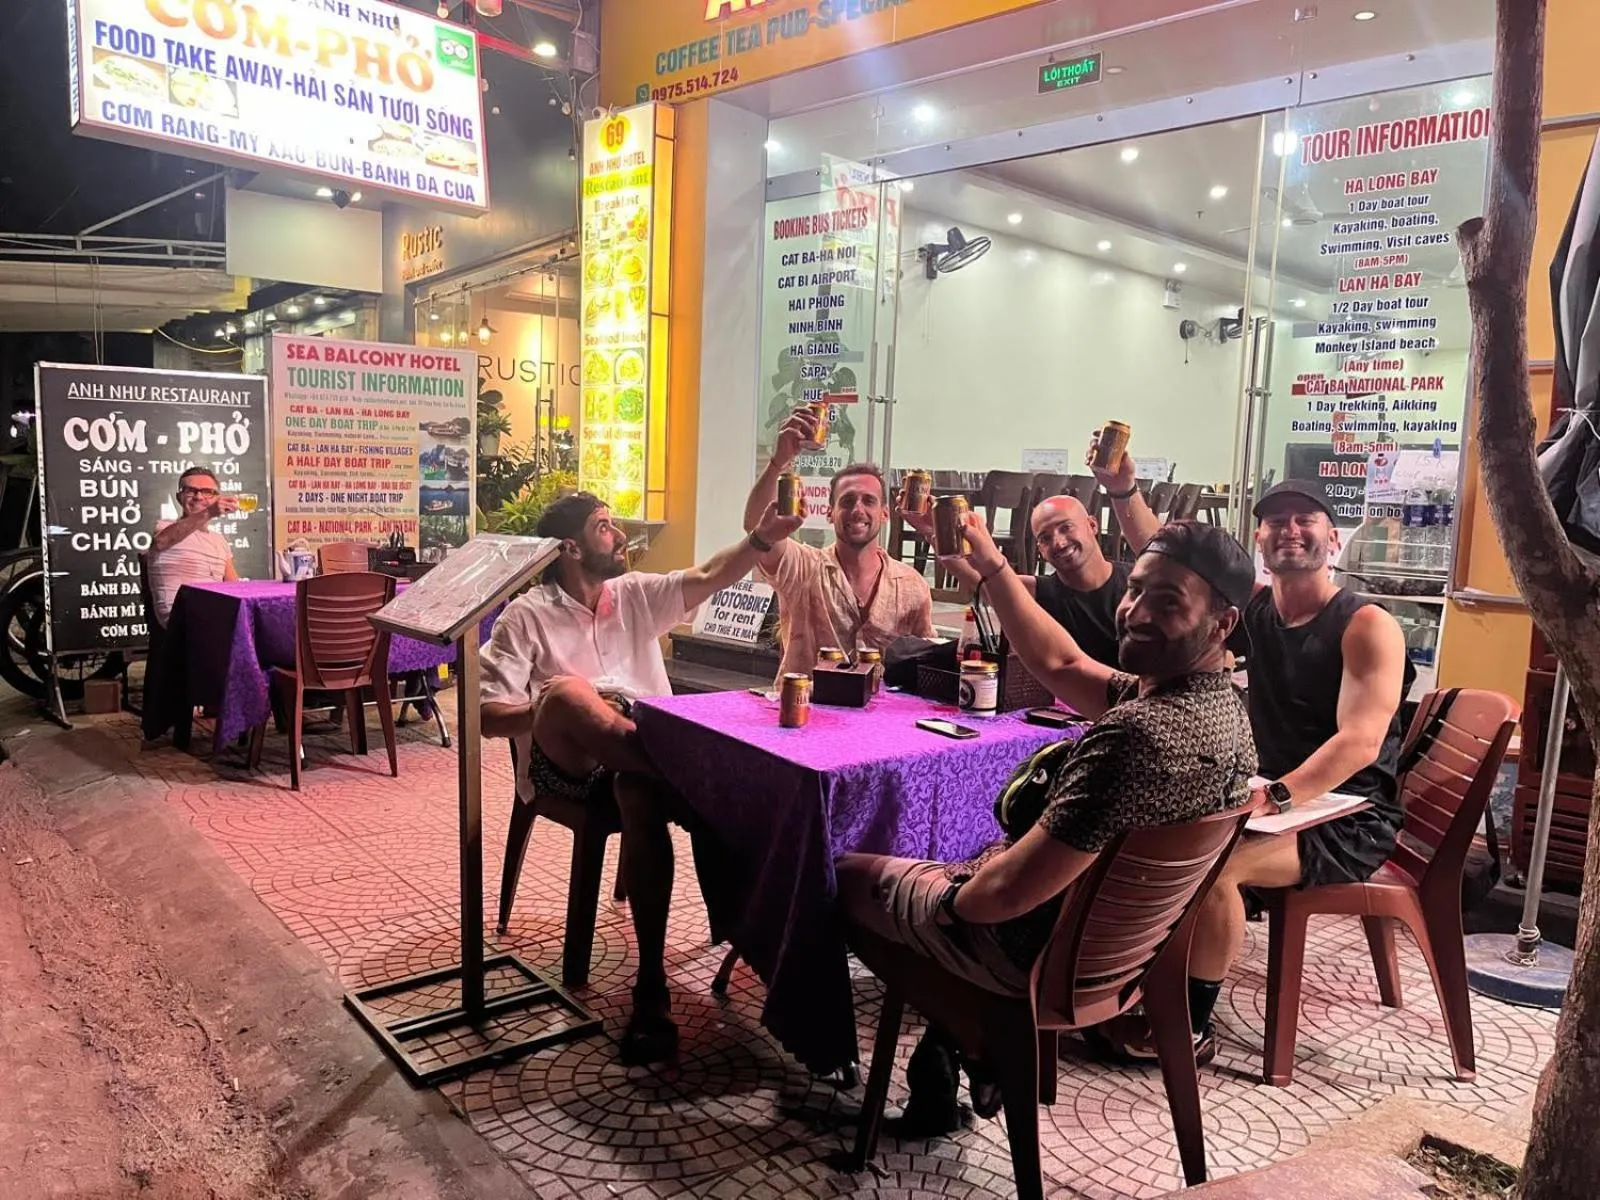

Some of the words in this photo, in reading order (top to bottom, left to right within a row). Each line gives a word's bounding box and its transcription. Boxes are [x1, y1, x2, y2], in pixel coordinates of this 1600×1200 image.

[95, 20, 156, 59] FOOD
[164, 38, 217, 74] TAKE
[655, 36, 720, 75] COFFEE
[726, 23, 762, 56] TEA
[651, 66, 739, 101] 0975.514.724
[1056, 76, 1080, 87] EXIT
[606, 120, 625, 148] 69
[102, 100, 153, 130] CƠM
[444, 179, 476, 202] CUA
[1301, 129, 1351, 165] TOUR
[1345, 178, 1364, 194] HA
[1368, 174, 1405, 192] LONG
[1410, 168, 1439, 187] BAY
[1349, 203, 1355, 213] 1
[1358, 199, 1377, 213] Day
[1381, 197, 1404, 209] boat
[1407, 194, 1430, 206] tour
[774, 215, 810, 240] BOOKING
[812, 212, 829, 235] BUS
[832, 206, 868, 233] TICKETS
[1333, 219, 1388, 236] Kayaking,
[1391, 213, 1439, 231] boating,
[1320, 238, 1383, 255] Swimming,
[1387, 236, 1411, 249] Visit
[1415, 232, 1450, 246] caves
[781, 253, 800, 267] CAT
[802, 249, 834, 265] BA-HA
[837, 245, 857, 259] NOI
[778, 276, 796, 289] CAT
[798, 274, 809, 288] BI
[812, 268, 857, 286] AIRPORT
[1339, 276, 1366, 293] LAN
[1370, 274, 1389, 290] HA
[1394, 271, 1422, 288] BAY
[788, 298, 806, 312] HAI
[808, 294, 845, 310] PHONG
[1332, 301, 1348, 314] 1/2
[1352, 300, 1374, 313] Day
[1376, 298, 1401, 311] boat
[1405, 296, 1429, 309] tour
[788, 322, 814, 335] NINH
[816, 318, 843, 333] BINH
[1317, 321, 1372, 335] Kayaking,
[1375, 317, 1437, 332] swimming
[790, 345, 804, 357] HA
[807, 342, 840, 356] GIANG
[1315, 341, 1358, 355] Monkey
[1361, 338, 1396, 352] Island
[1400, 336, 1436, 350] beach
[287, 343, 320, 362] SEA
[324, 346, 406, 369] BALCONY
[410, 354, 461, 372] HOTEL
[1343, 359, 1370, 373] (Any
[1373, 358, 1404, 372] time)
[801, 366, 827, 378] SAPA
[287, 367, 356, 391] TOURIST
[361, 371, 464, 398] INFORMATION
[1305, 379, 1326, 393] CAT
[1329, 379, 1347, 393] BA
[1349, 377, 1406, 392] NATIONAL
[1411, 376, 1444, 391] PARK
[68, 383, 104, 399] ANH
[110, 384, 147, 401] NHƯ
[151, 386, 251, 406] RESTAURANT
[803, 389, 823, 401] HUE
[290, 404, 304, 414] CAT
[306, 405, 318, 414] BA
[325, 406, 341, 416] LAN
[343, 406, 354, 416] HA
[361, 407, 372, 417] HA
[374, 409, 394, 418] LONG
[396, 410, 410, 419] BAY
[1307, 401, 1312, 411] 1
[1316, 401, 1336, 413] Day
[1339, 399, 1389, 412] trekking,
[1392, 398, 1437, 412] Aikking
[64, 411, 148, 453] CƠM
[177, 410, 251, 455] PHỞ
[286, 416, 307, 428] ONE
[309, 416, 328, 429] DAY
[330, 417, 355, 430] BOAT
[356, 419, 379, 431] TRIP
[1292, 420, 1334, 433] Boating,
[1337, 420, 1399, 433] swimming,
[1403, 418, 1457, 433] kayaking
[287, 443, 299, 453] CAT
[300, 443, 310, 453] BA
[316, 444, 329, 454] LAN
[330, 444, 340, 454] HA
[341, 445, 353, 454] BAY
[359, 445, 384, 455] FISHING
[385, 447, 413, 456] VILLAGES
[79, 456, 133, 474] SÁNG
[211, 457, 240, 475] TỐI
[286, 456, 294, 467] A
[296, 456, 321, 467] HALF
[323, 457, 341, 468] DAY
[344, 457, 369, 468] BOAT
[371, 458, 392, 469] TRIP
[1320, 462, 1339, 477] HA
[80, 474, 139, 498] BÚN
[1325, 485, 1333, 497] 2
[1335, 484, 1358, 498] Day
[298, 492, 303, 503] 2
[305, 492, 324, 503] DAYS
[331, 492, 345, 503] ONE
[347, 492, 368, 503] NIGHT
[370, 492, 386, 503] BOAT
[388, 493, 404, 504] TRIP
[81, 500, 142, 525] PHỞ
[1369, 506, 1383, 517] on
[287, 520, 300, 534] CAT
[302, 520, 312, 534] BA
[319, 521, 353, 534] NATIONAL
[354, 521, 372, 534] PARK
[71, 528, 152, 551] CHÁO
[81, 580, 118, 597] BÁNH
[121, 582, 141, 595] ĐA
[81, 604, 118, 620] BÁNH
[121, 601, 136, 618] MÌ
[710, 590, 770, 614] MOTORBIKE
[713, 607, 730, 620] for
[731, 612, 756, 626] rent
[101, 623, 129, 638] CƠM
[704, 622, 717, 632] CHO
[732, 626, 742, 637] XE
